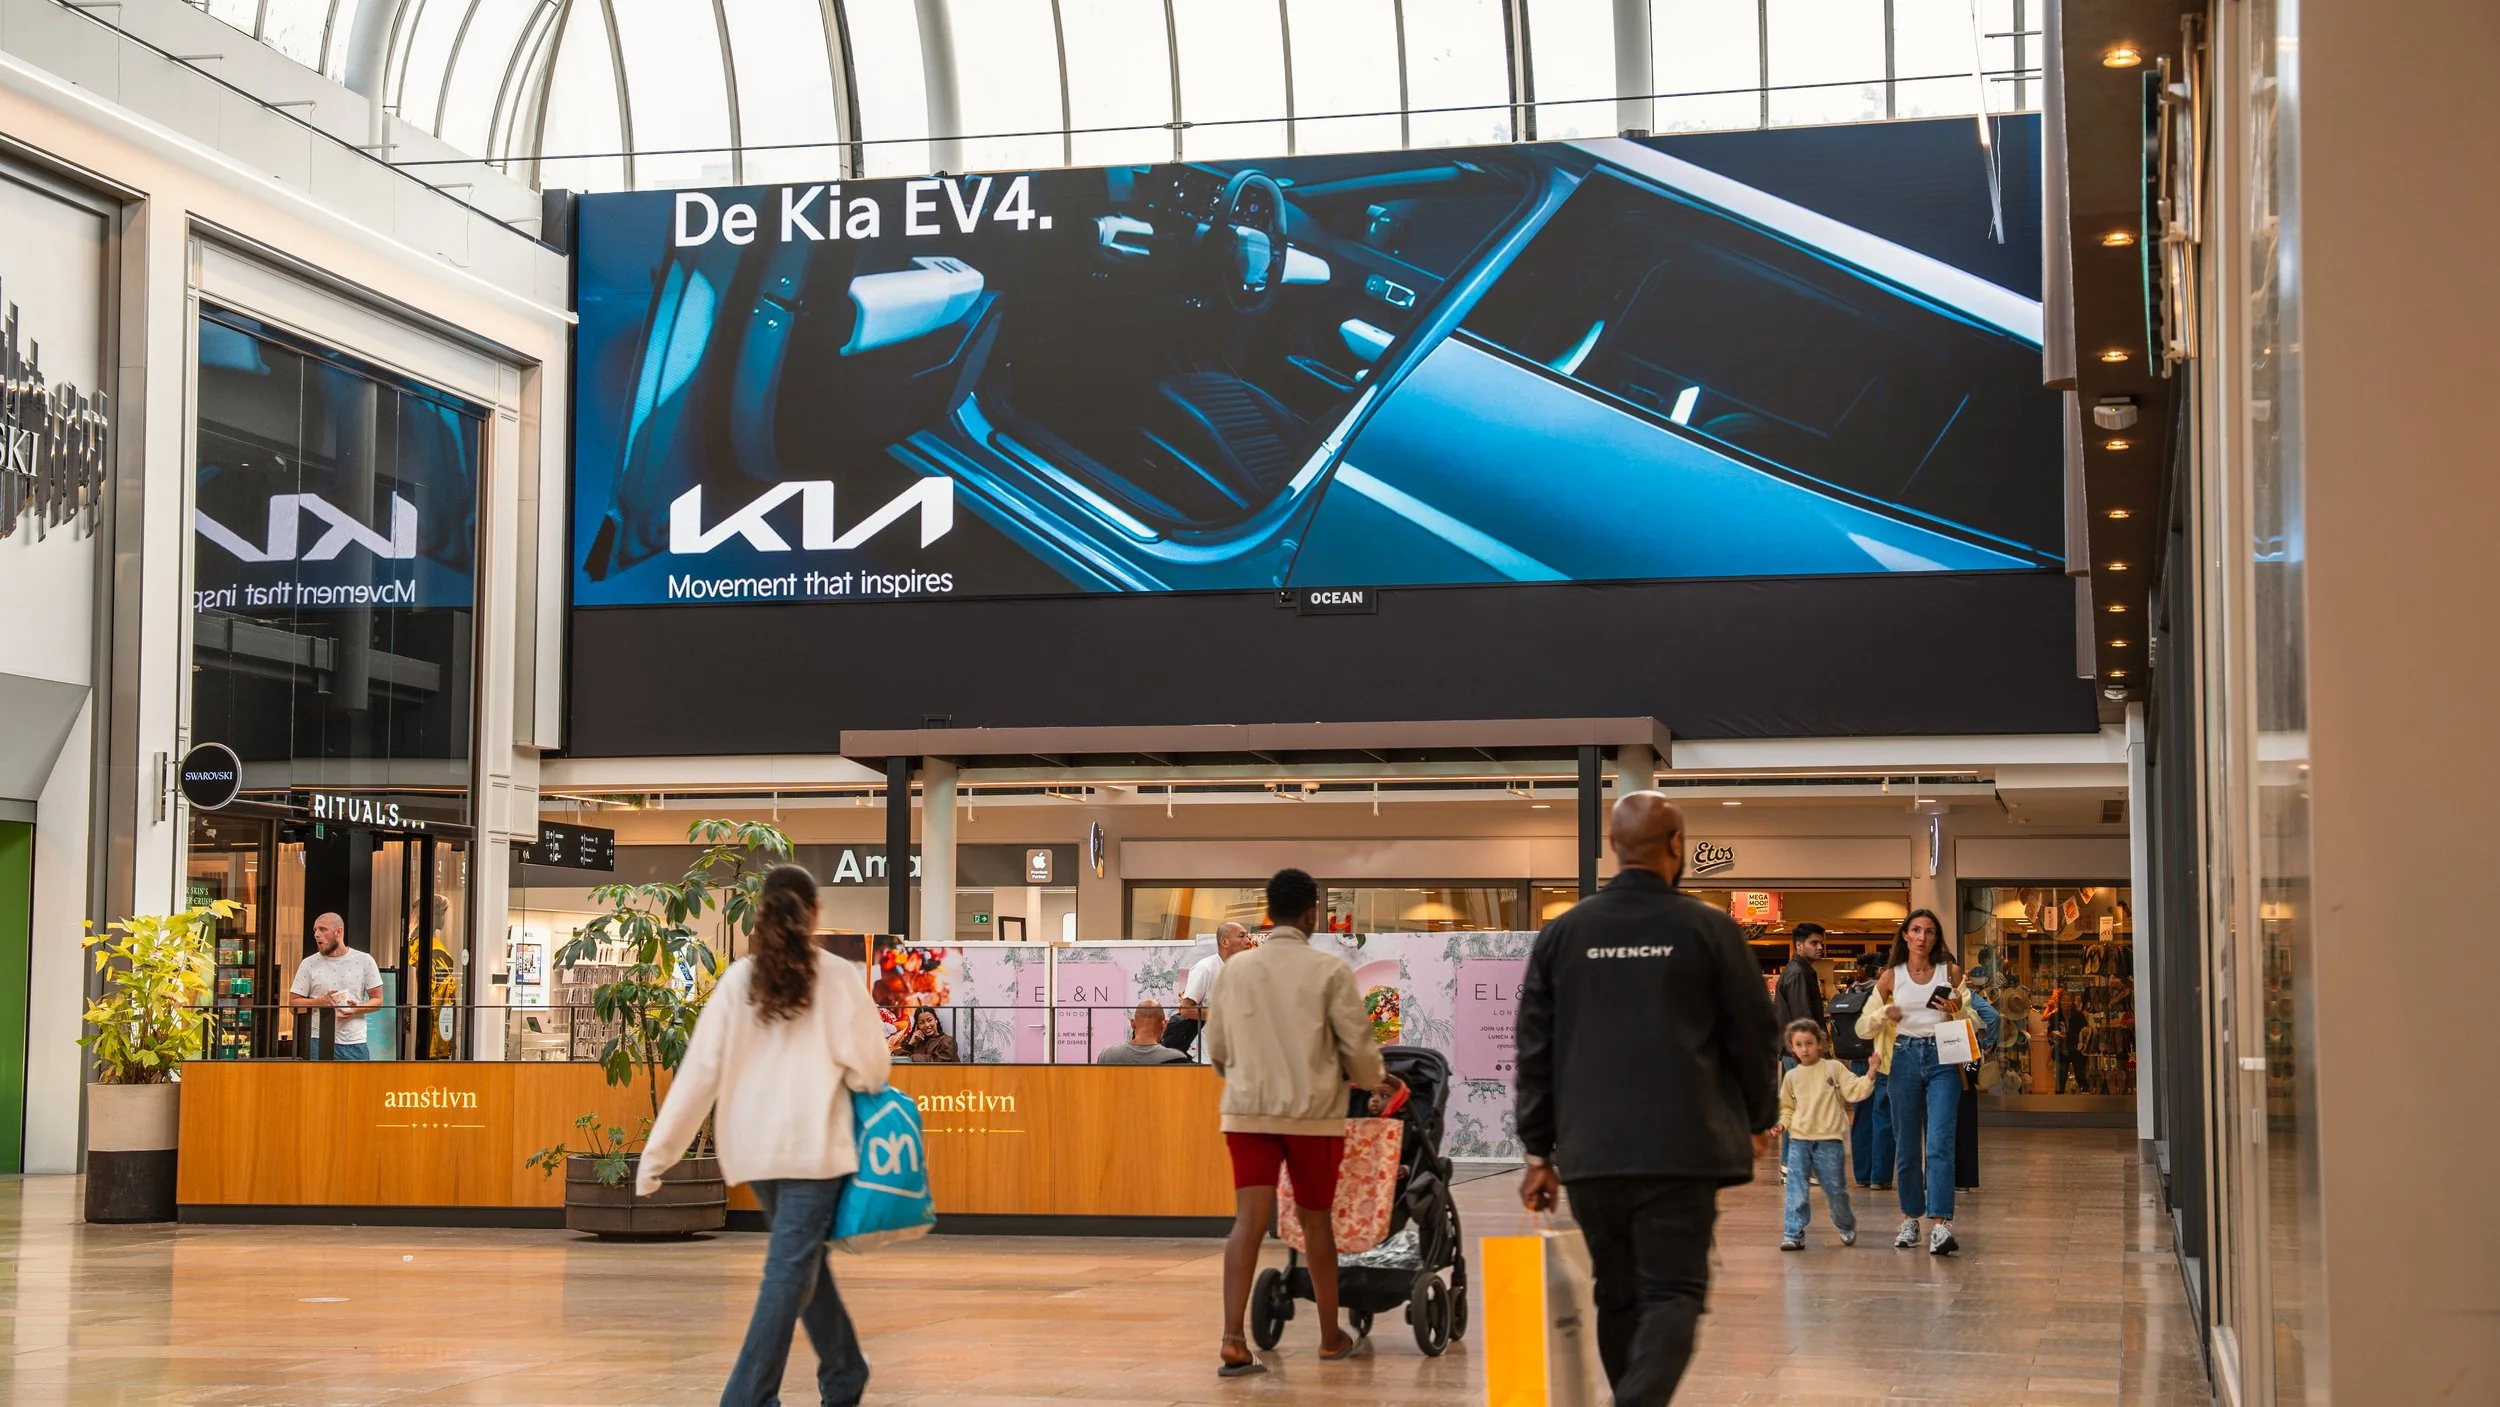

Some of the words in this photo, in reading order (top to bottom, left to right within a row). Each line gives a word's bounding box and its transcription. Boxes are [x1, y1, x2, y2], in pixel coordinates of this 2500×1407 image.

[675, 191, 758, 247] De
[781, 184, 880, 242] Kia
[905, 175, 1053, 236] EV4.
[670, 476, 954, 554] KIA
[668, 573, 797, 599] Movement
[804, 570, 853, 595] that
[861, 568, 953, 598] inspires
[1310, 591, 1363, 604] OCEAN
[185, 771, 233, 781] SWAROVSKI
[1694, 841, 1735, 863] Etos
[1586, 946, 1674, 958] GIVENCHY
[384, 1086, 478, 1108] amstlvn
[917, 1089, 1016, 1113] amstlvn
